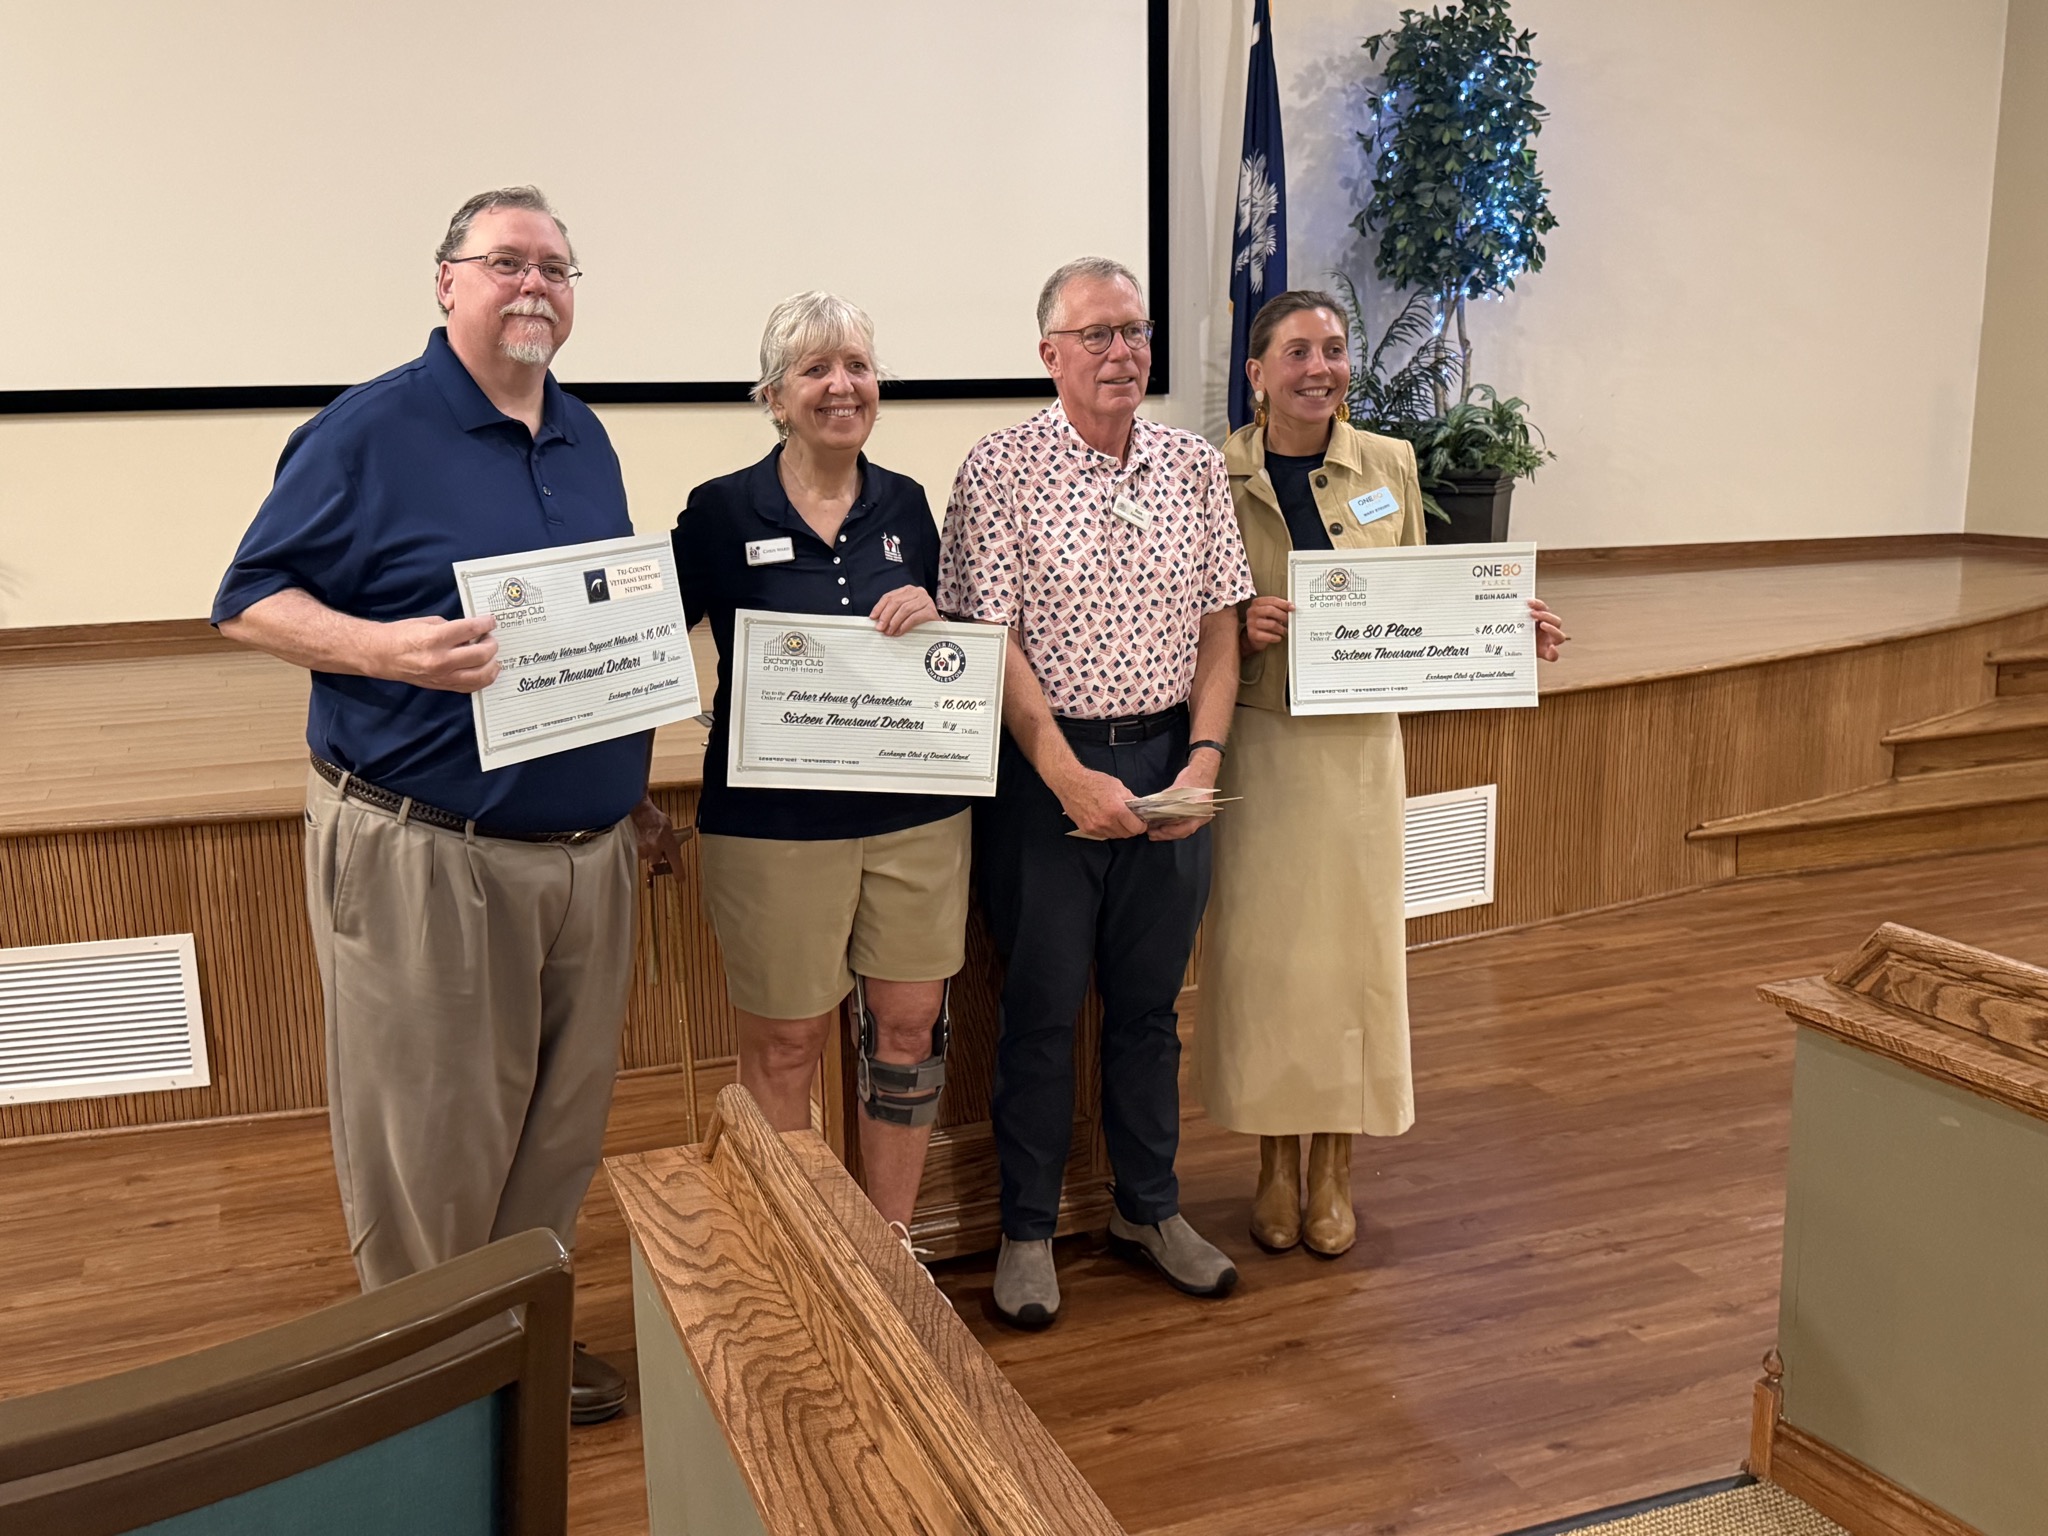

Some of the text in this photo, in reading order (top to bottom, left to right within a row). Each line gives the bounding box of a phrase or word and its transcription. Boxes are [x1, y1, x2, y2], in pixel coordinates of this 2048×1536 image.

[617, 564, 652, 576] TRI-COUNTY
[1472, 563, 1522, 578] ONE80
[624, 583, 653, 594] NETWORK
[1310, 592, 1367, 602] Exchange Club
[528, 605, 545, 616] Club
[501, 615, 547, 629] Daniel Island
[1334, 622, 1423, 640] One 80 Place
[518, 632, 639, 666] Tri-County Veterans Support Network
[1331, 648, 1372, 661] Sixteen
[1374, 646, 1427, 660] Thousand
[1426, 645, 1470, 658] Dollars
[763, 656, 824, 667] Exchange Club
[517, 675, 557, 692] Sixteen
[559, 661, 606, 684] Thousand
[606, 656, 641, 674] Dollars
[800, 666, 824, 674] Island
[926, 667, 963, 682] CHARLESTON
[1425, 670, 1516, 682] Exchange Club of Daniel Island
[608, 689, 632, 701] Exchange
[631, 685, 643, 696] Club
[643, 684, 650, 695] of
[649, 680, 665, 691] Daniel
[786, 690, 913, 709] Fisher House of Charleston
[933, 701, 939, 709] $
[780, 711, 824, 725] Sixteen
[825, 713, 882, 728] Thousand
[880, 715, 925, 730] Dollars
[878, 749, 971, 761] Exchange Club of Daniel Island
